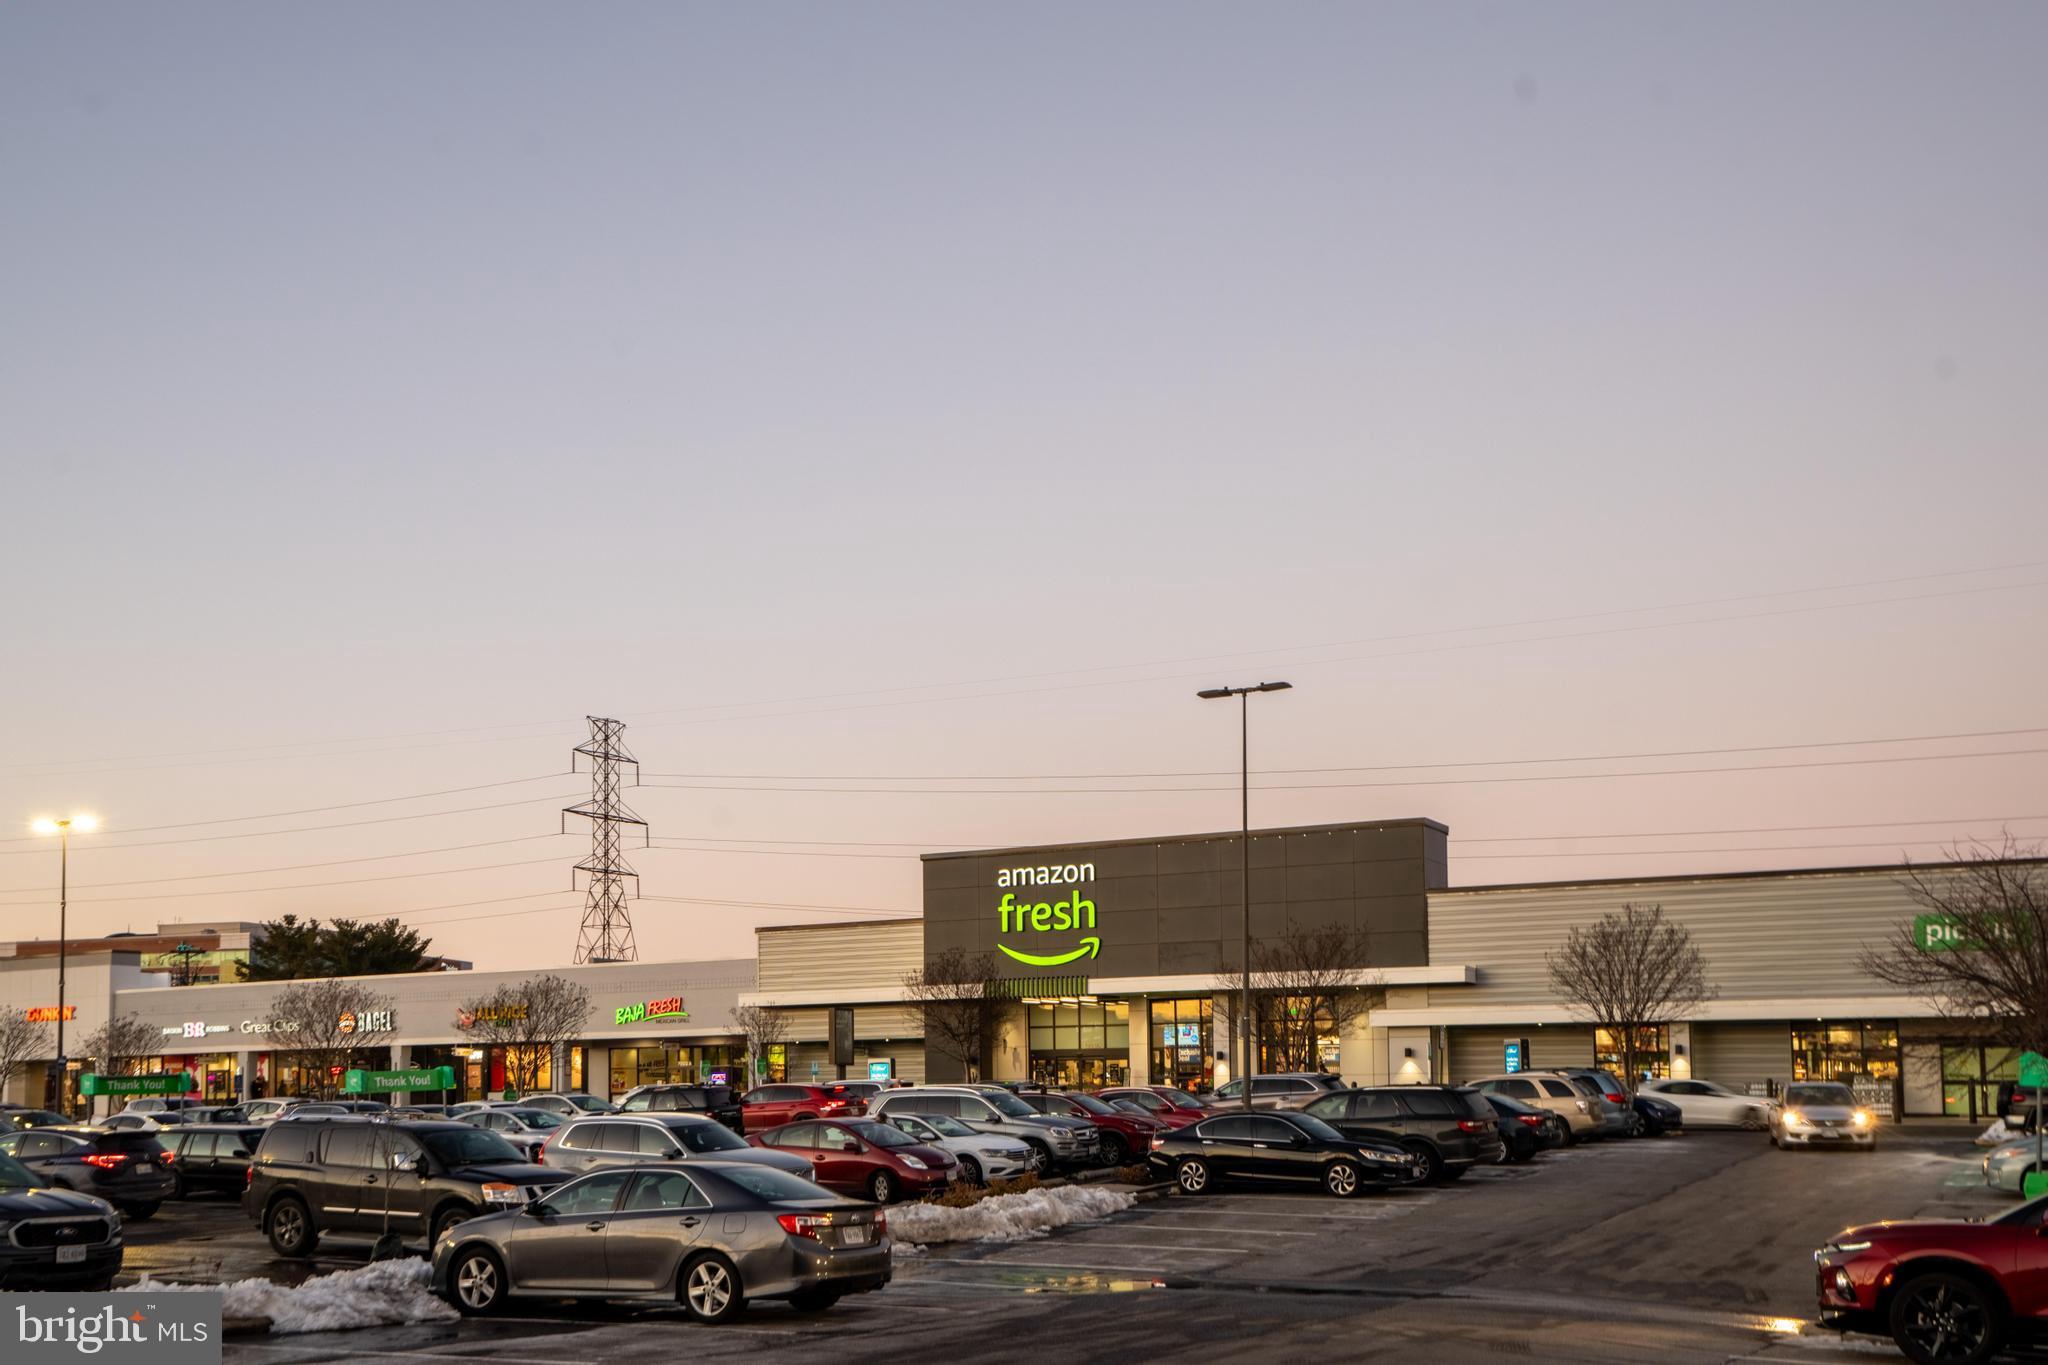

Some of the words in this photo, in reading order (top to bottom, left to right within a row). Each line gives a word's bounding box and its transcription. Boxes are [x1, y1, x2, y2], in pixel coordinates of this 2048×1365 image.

[998, 863, 1095, 888] amazon
[998, 890, 1096, 933] fresh
[26, 1006, 77, 1022] DUNKN'
[616, 1002, 645, 1025] BAJA
[647, 997, 682, 1017] FRESH
[183, 1021, 206, 1038] BR
[240, 1020, 272, 1034] Great
[273, 1020, 300, 1034] Clips
[357, 1011, 393, 1033] BAGEL
[107, 1080, 140, 1091] Thank
[142, 1079, 165, 1090] You!
[374, 1077, 407, 1088] Thank
[409, 1075, 431, 1086] You!
